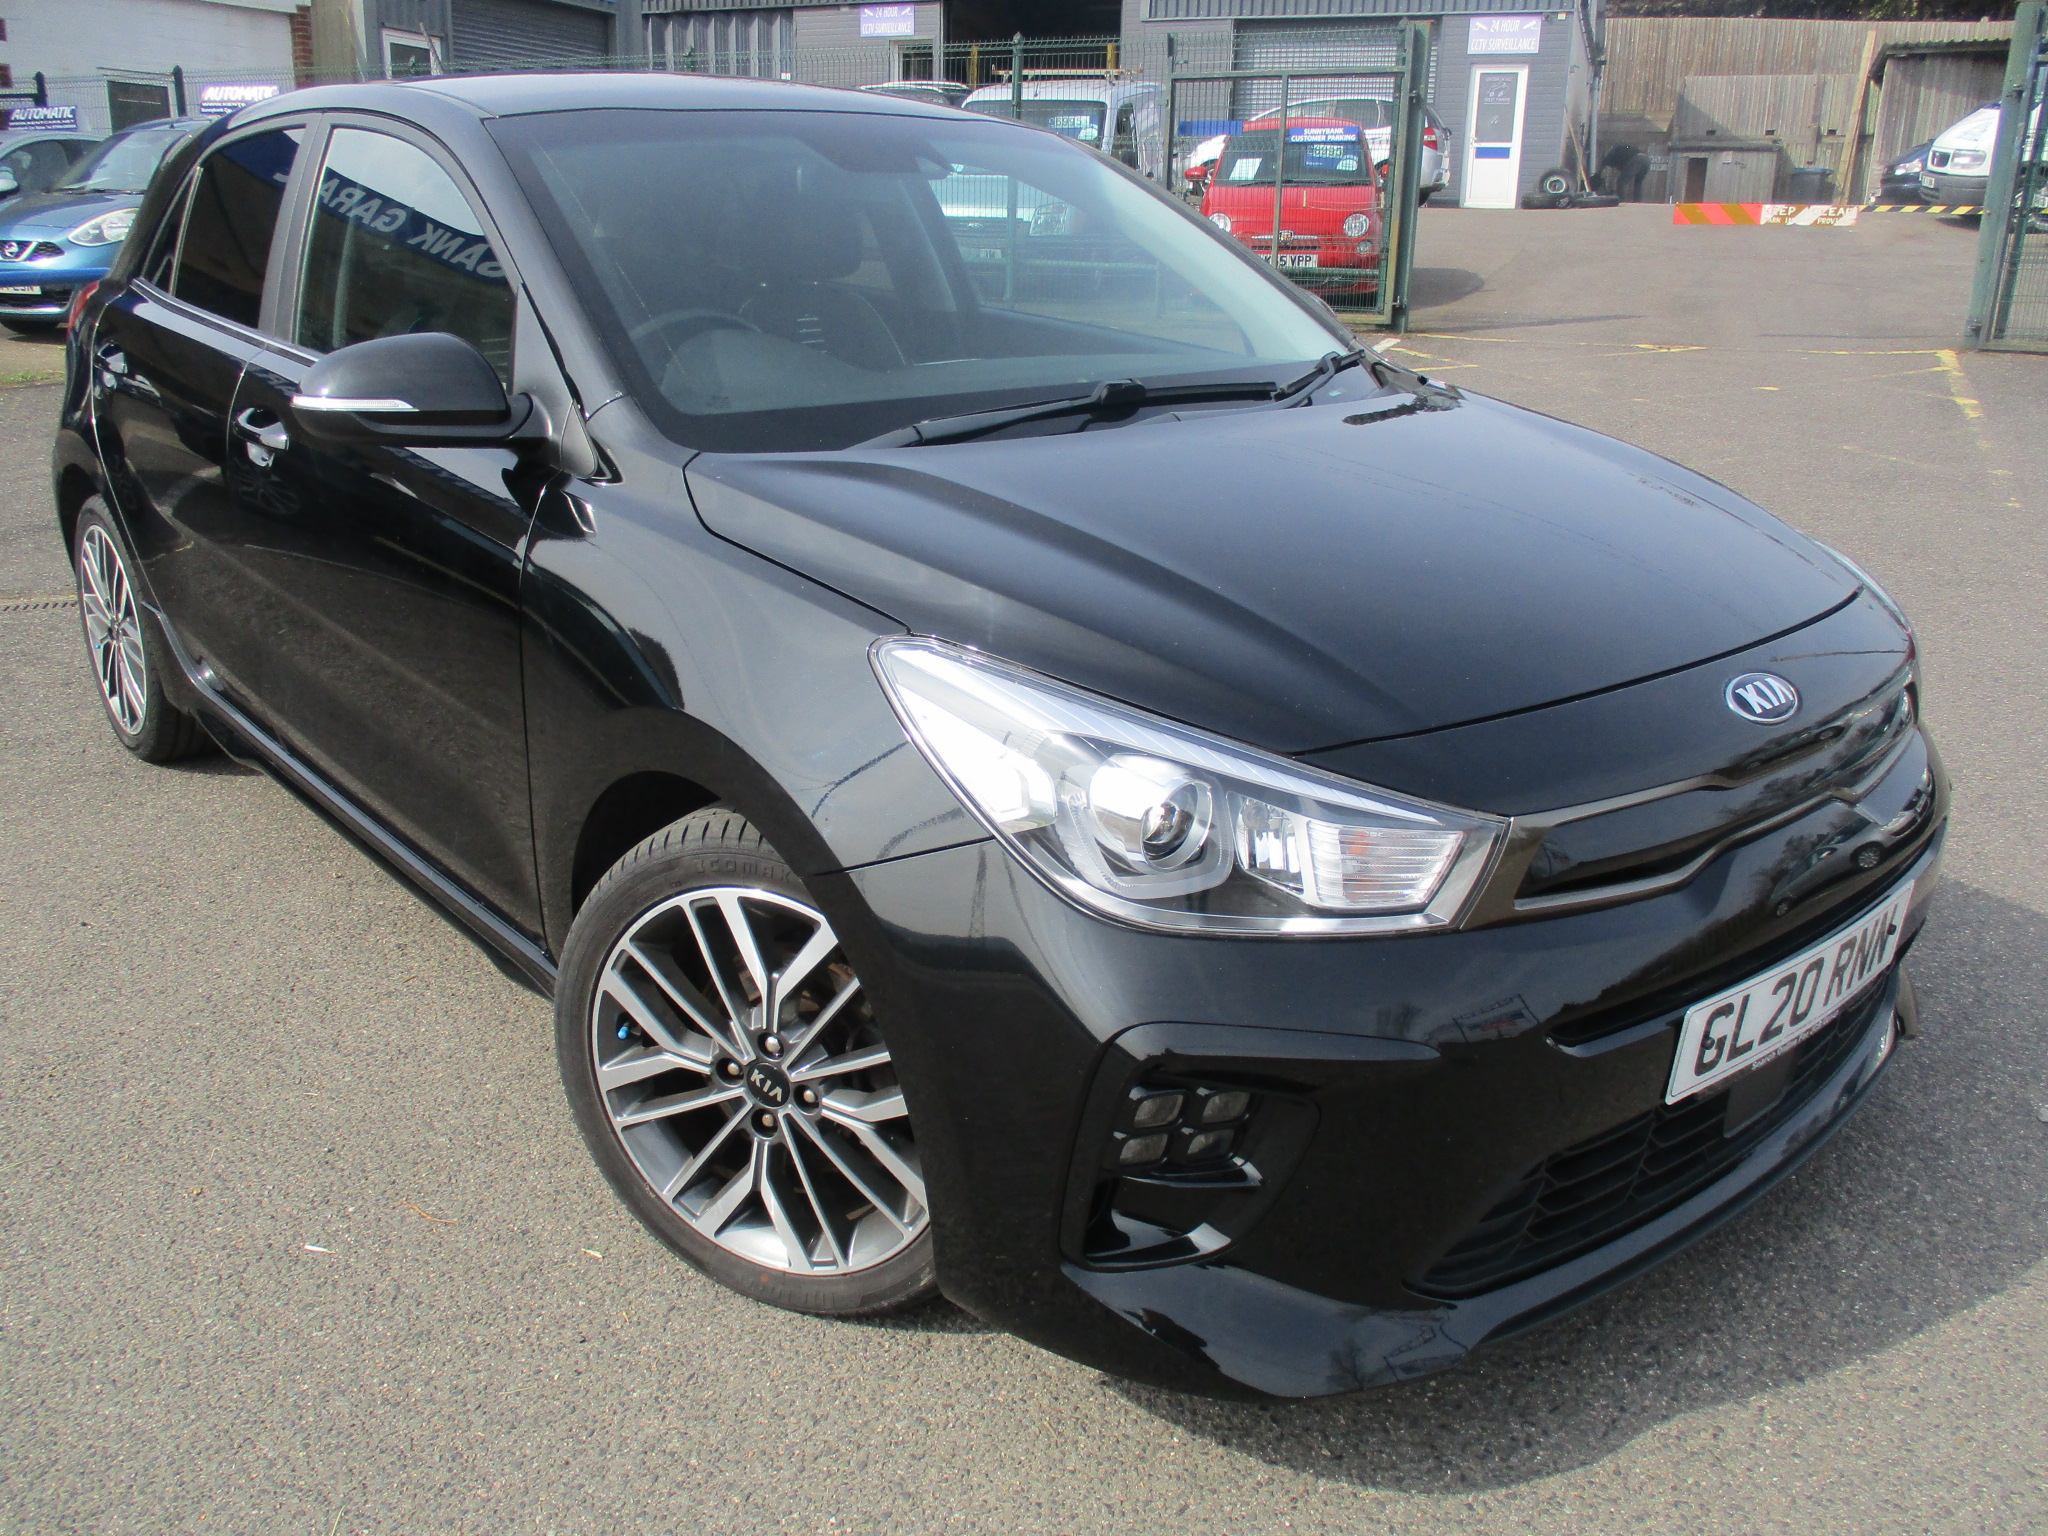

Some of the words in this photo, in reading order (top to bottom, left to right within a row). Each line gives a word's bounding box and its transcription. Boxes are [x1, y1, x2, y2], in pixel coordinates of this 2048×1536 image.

[883, 6, 898, 17] HOUR
[862, 23, 875, 35] CCTV
[875, 22, 911, 33] SURVEILLANCE
[1490, 20, 1499, 32] 24
[1500, 19, 1521, 32] HOUR
[1471, 38, 1488, 51] CCTV
[1488, 37, 1537, 50] SURVEILLANCE
[203, 86, 279, 102] AUTOMATIC
[11, 106, 76, 120] AUTOMATIC
[1291, 134, 1326, 142] CUSTOMER
[1327, 133, 1356, 141] PARKING
[1303, 127, 1344, 135] SUNNYBANK
[1290, 254, 1312, 267] VPP
[1735, 677, 1794, 714] KIA
[1694, 956, 1825, 1077] GL20
[1823, 903, 1898, 1007] RNN
[750, 1068, 783, 1102] KIA
